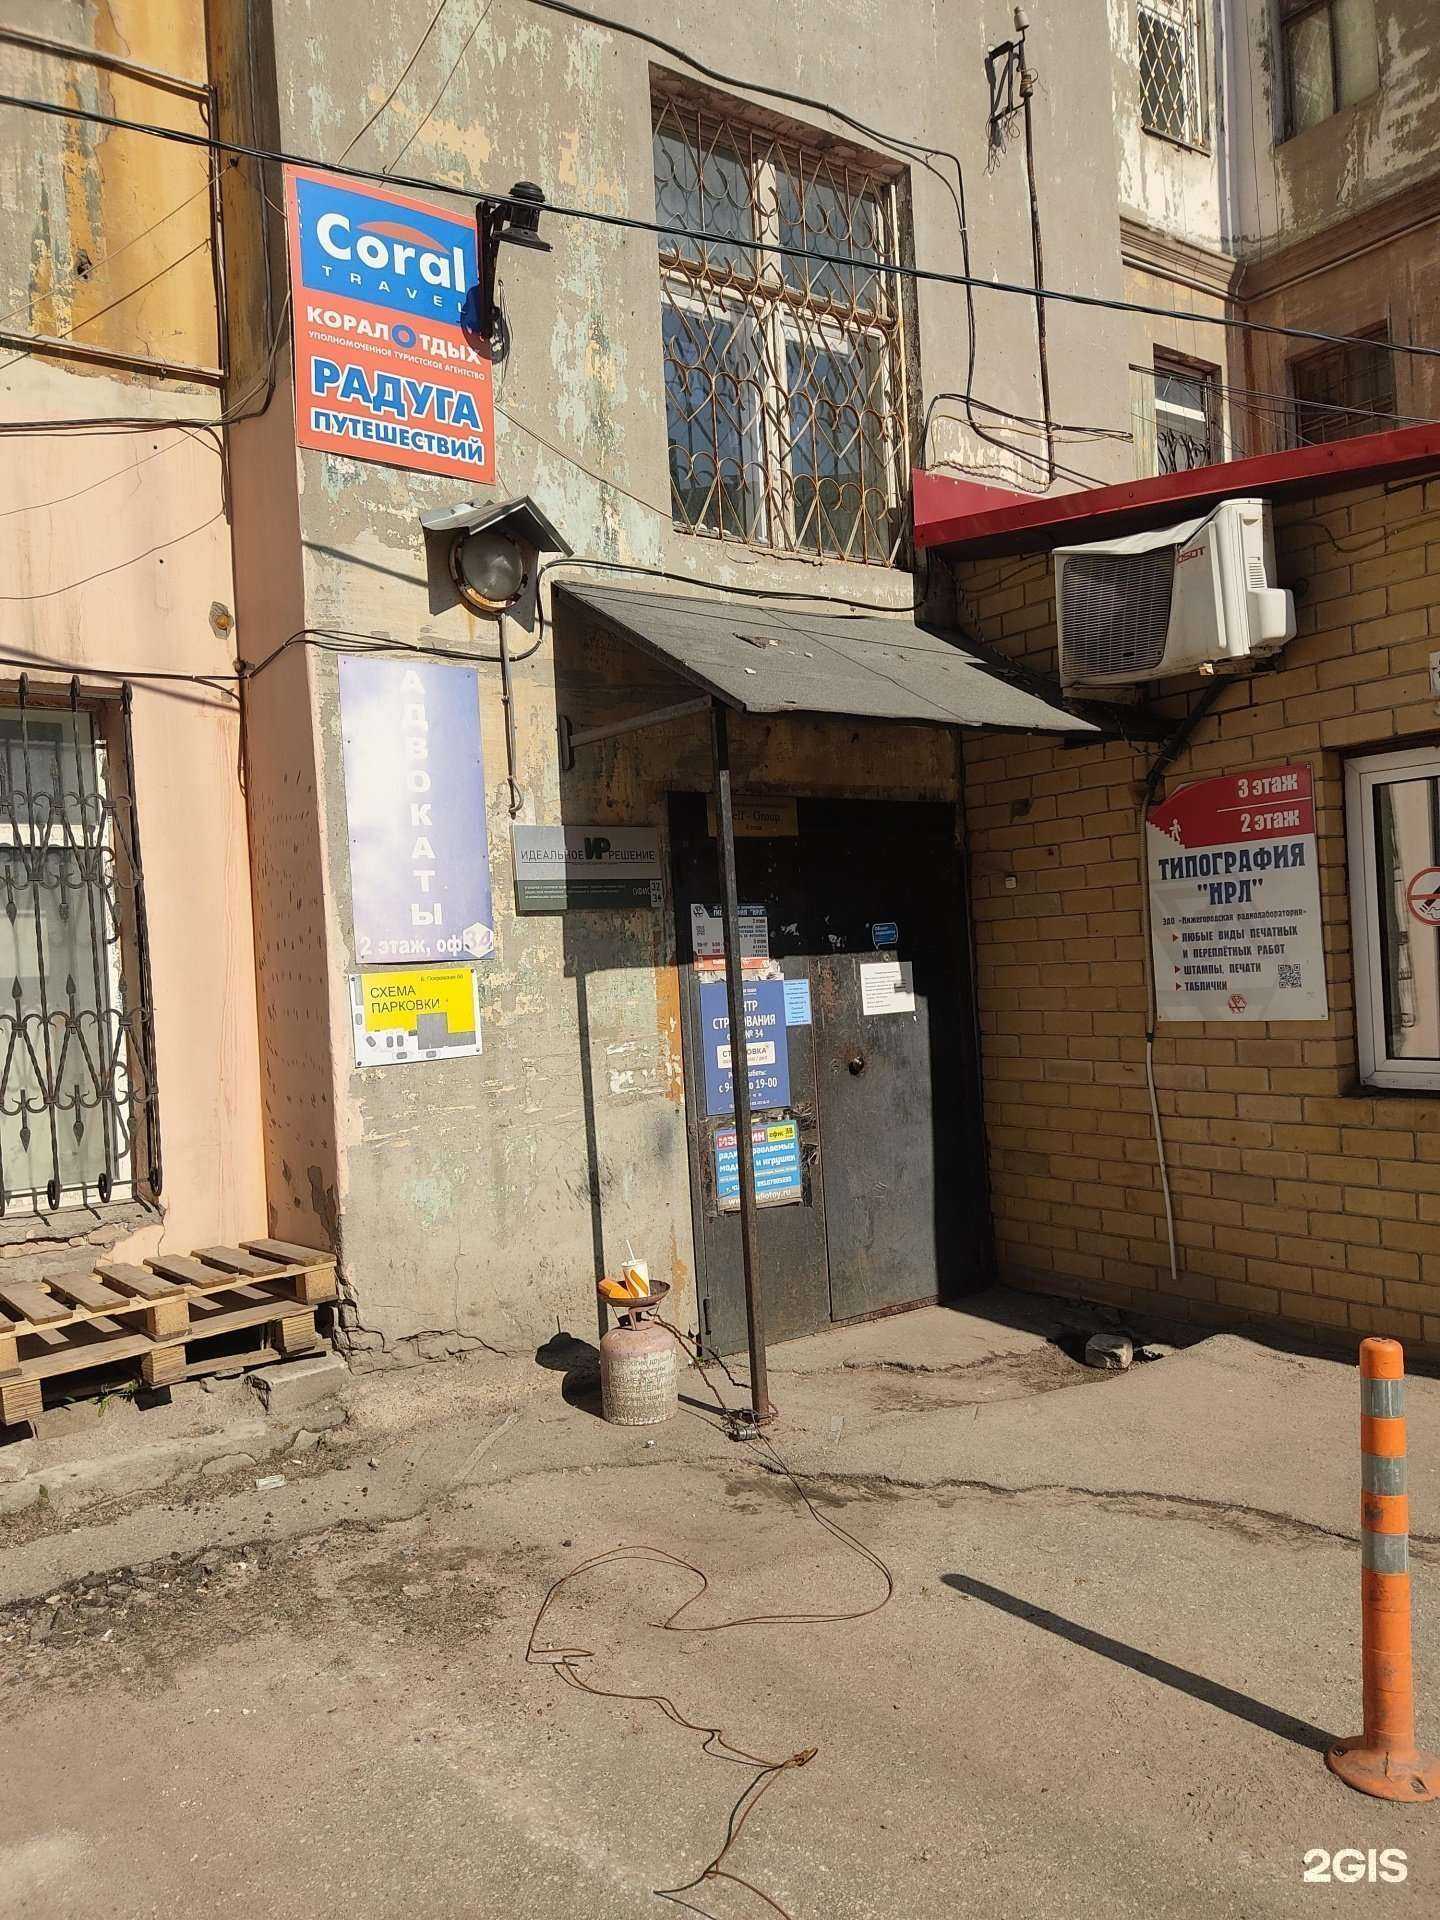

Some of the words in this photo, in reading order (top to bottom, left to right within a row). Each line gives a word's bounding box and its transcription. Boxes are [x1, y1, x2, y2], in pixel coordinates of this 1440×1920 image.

[316, 213, 466, 293] Coral
[321, 265, 468, 313] TRAVEL
[307, 305, 389, 341] КОРАЛ
[309, 331, 392, 357] УПОЛНОМОЧЕННОЕ
[395, 350, 443, 370] ТУРИСТСКОЕ
[445, 363, 485, 381] АГЕНТСТВО
[311, 356, 484, 433] РАДУГА
[311, 408, 485, 466] ПУТЕШЕСТВИЙ
[1238, 778, 1249, 798] 3
[1252, 773, 1298, 796] этаж
[401, 670, 443, 926] АДВОКАТЫ
[1240, 813, 1251, 833] 2
[1254, 809, 1300, 831] этаж
[520, 850, 584, 861] ИДЕАЛЬНОЕ
[608, 850, 656, 860] РЕШЕНИЕ
[1158, 842, 1305, 880] ТИПОГРАФИЯ
[1182, 931, 1213, 942] ЛЮБЫЕ
[1218, 928, 1245, 941] ВИДЫ
[1250, 926, 1298, 938] ПЕЧАТНЫХ
[360, 936, 371, 955] 2
[378, 939, 431, 957] этаж,
[1183, 950, 1188, 958] И
[1193, 946, 1252, 958] ПЕРЕПЛЁТНЫХ
[1257, 944, 1285, 955] РАБОТ
[1229, 962, 1262, 973] ПЕЧАТИ
[370, 985, 417, 999] СХЕМА
[1185, 981, 1227, 992] ТАБЛИЧКИ
[371, 998, 440, 1014] ПАРКОВКИ
[713, 1014, 776, 1030] СТРВАНИЯ
[755, 1077, 777, 1089] 19-00
